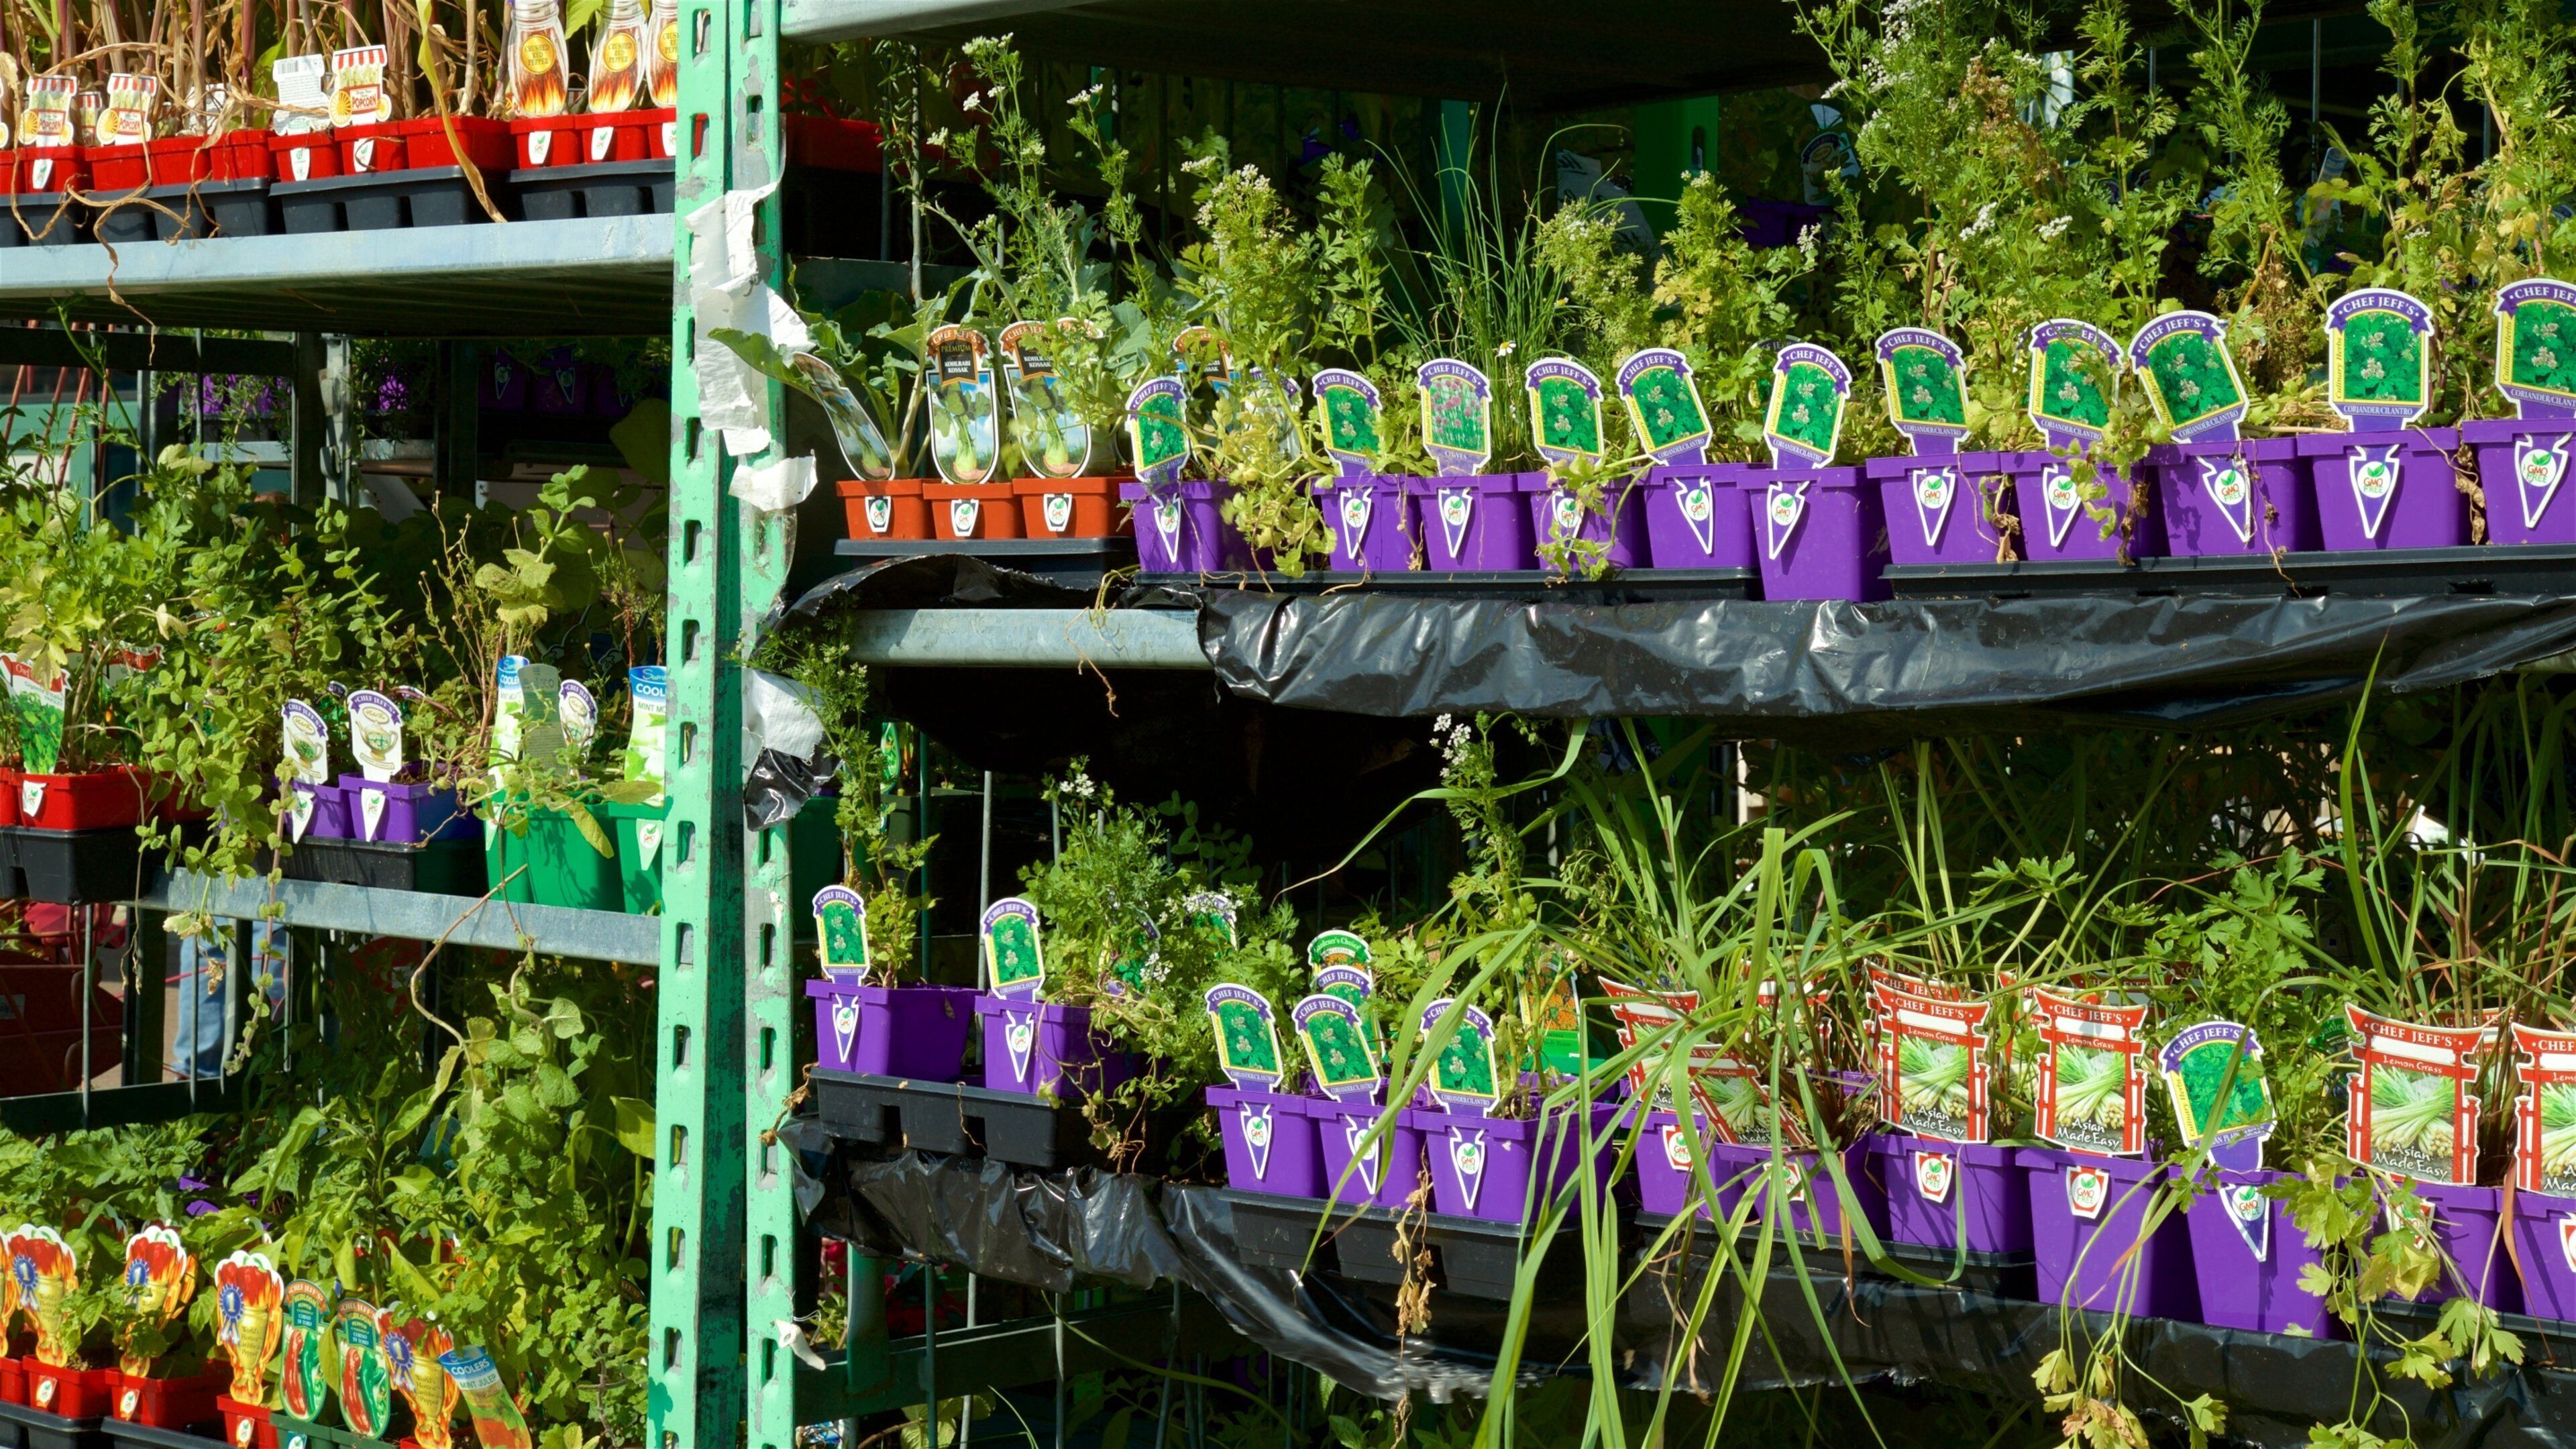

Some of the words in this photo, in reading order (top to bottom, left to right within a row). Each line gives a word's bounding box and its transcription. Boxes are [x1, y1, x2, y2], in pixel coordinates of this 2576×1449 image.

[525, 44, 550, 52] CRUSHED
[352, 95, 376, 107] POPCORN
[40, 119, 60, 130] POPCORN
[2515, 286, 2549, 300] CHEF
[2343, 297, 2375, 315] CHEF
[2378, 297, 2414, 315] JEFF'S
[932, 330, 952, 344] CHEF
[954, 329, 977, 343] JEFF'S
[1008, 327, 1027, 340] CHEF
[2139, 325, 2163, 350] CHEF
[2165, 317, 2201, 333] JEFF'S
[941, 344, 971, 352] PREMIUM
[1886, 334, 1913, 347] CHEF
[1915, 335, 1947, 352] JEFF'S
[1624, 360, 1644, 380] CHEF
[1645, 355, 1674, 366] JEFF'S
[1790, 350, 1814, 360] CHEF
[1816, 352, 1843, 377] JEFF'S
[2502, 351, 2512, 382] Culinary
[1428, 364, 1450, 376] CHEF
[1452, 365, 1478, 384] JEFF'S
[1536, 365, 1559, 377] CHEF
[1560, 366, 1589, 384] JEFF'S
[1322, 375, 1340, 384] CHEF
[1343, 376, 1368, 394] JEFF'S
[1135, 390, 1152, 405] CHEF
[1153, 382, 1174, 392] JEFF'S
[2035, 382, 2043, 413] Culinary
[2510, 388, 2576, 408] CORIANDER/CILANT
[2343, 405, 2413, 415] CORIANDER/CILANTRO
[1904, 425, 1962, 435] CORIANDER/CILANTRO
[2041, 419, 2102, 441] CORIANDER/CILANTRO
[2178, 410, 2239, 438] CORIANDER/CILANTRO
[1444, 451, 1468, 460] CHIVES
[1658, 438, 1705, 459] CORIANDER/CILANTRO
[1773, 439, 1822, 462] CORIANDER/CILANTRO
[2527, 464, 2548, 476] GMO
[2363, 477, 2383, 486] GMO
[2526, 472, 2547, 483] FREE
[1924, 490, 1941, 498] GMO
[2053, 489, 2071, 500] GMO
[2221, 484, 2239, 496] GMO
[2223, 492, 2243, 502] FREE
[2363, 486, 2383, 494] FREE
[1691, 502, 1705, 513] GMO
[2052, 497, 2070, 507] FREE
[1448, 508, 1461, 516] GMO
[1561, 510, 1574, 519] GMO
[1776, 506, 1790, 515] GMO
[1775, 515, 1789, 523] FREE
[567, 684, 579, 693] CHEF
[636, 683, 665, 697] COOL
[374, 697, 394, 713] JEFF'S
[637, 702, 655, 710] MINT
[288, 704, 302, 712] CHEF
[303, 709, 319, 727] JEFF'S
[818, 890, 835, 904] CHEF
[835, 891, 855, 904] JEFF'S
[987, 906, 1005, 921] CHEF
[1006, 903, 1028, 915] JEFF'S
[1341, 938, 1362, 950] Choice
[1337, 972, 1362, 985] JEFF'S
[1882, 978, 1909, 991] CHEF
[1213, 989, 1232, 1001] CHEF
[1234, 989, 1259, 1006] JEFF'S
[1300, 1002, 1318, 1018] CHEF
[1319, 1001, 1346, 1012] JEFF'S
[1895, 998, 1925, 1012] CHEF
[1930, 1004, 1964, 1018] JEFF'S
[2054, 1004, 2085, 1017] CHEF
[2088, 1010, 2123, 1023] JEFF'S
[1638, 1016, 1661, 1025] Lemon
[1909, 1026, 1934, 1038] Lemon
[1935, 1032, 1957, 1042] Grass
[2172, 1032, 2201, 1055] CHEF
[2203, 1027, 2240, 1040] JEFF'S
[2369, 1022, 2406, 1039] CHEF
[2411, 1032, 2453, 1047] JEFF'S
[2065, 1034, 2091, 1046] Lemon
[2092, 1039, 2114, 1050] Grass
[2538, 1040, 2575, 1050] CHEF
[2383, 1055, 2415, 1068] Lemon
[2416, 1061, 2443, 1074] Grass
[1230, 1071, 1275, 1081] CORIANDER/CILANTRO
[1331, 1083, 1373, 1094] CORIANDER/CILANTRO
[2175, 1078, 2186, 1103] Herbs
[1441, 1094, 1491, 1106] CORIANDER/CILANTRO
[1917, 1105, 1949, 1121] Asian
[2182, 1104, 2195, 1136] Culinary
[1902, 1113, 1937, 1130] Made
[1938, 1119, 1965, 1138] Easy
[2072, 1118, 2105, 1132] Asian
[2056, 1127, 2090, 1142] Made
[2092, 1134, 2120, 1150] Easy
[2392, 1144, 2430, 1161] Asian
[1461, 1156, 1476, 1164] GMO
[2373, 1152, 2414, 1171] Made
[2416, 1161, 2448, 1181] Easy
[1925, 1172, 1941, 1181] GMO
[1925, 1179, 1941, 1187] FREE
[2077, 1187, 2094, 1197] GMO
[2239, 1199, 2259, 1212] GMO
[2241, 1208, 2261, 1218] FREE
[22, 1263, 28, 1276] 1
[135, 1267, 141, 1283] 1
[291, 1284, 303, 1293] CHEF
[305, 1285, 320, 1301] JEFF'S
[228, 1293, 235, 1312] 1
[242, 1326, 259, 1334] World's
[242, 1350, 258, 1358] Pepper
[395, 1342, 405, 1360] 1
[451, 1358, 490, 1376] COOLERS
[416, 1375, 435, 1383] World's
[460, 1381, 476, 1389] MINT
[477, 1374, 496, 1387] JULEP
[420, 1397, 438, 1405] Pepper
